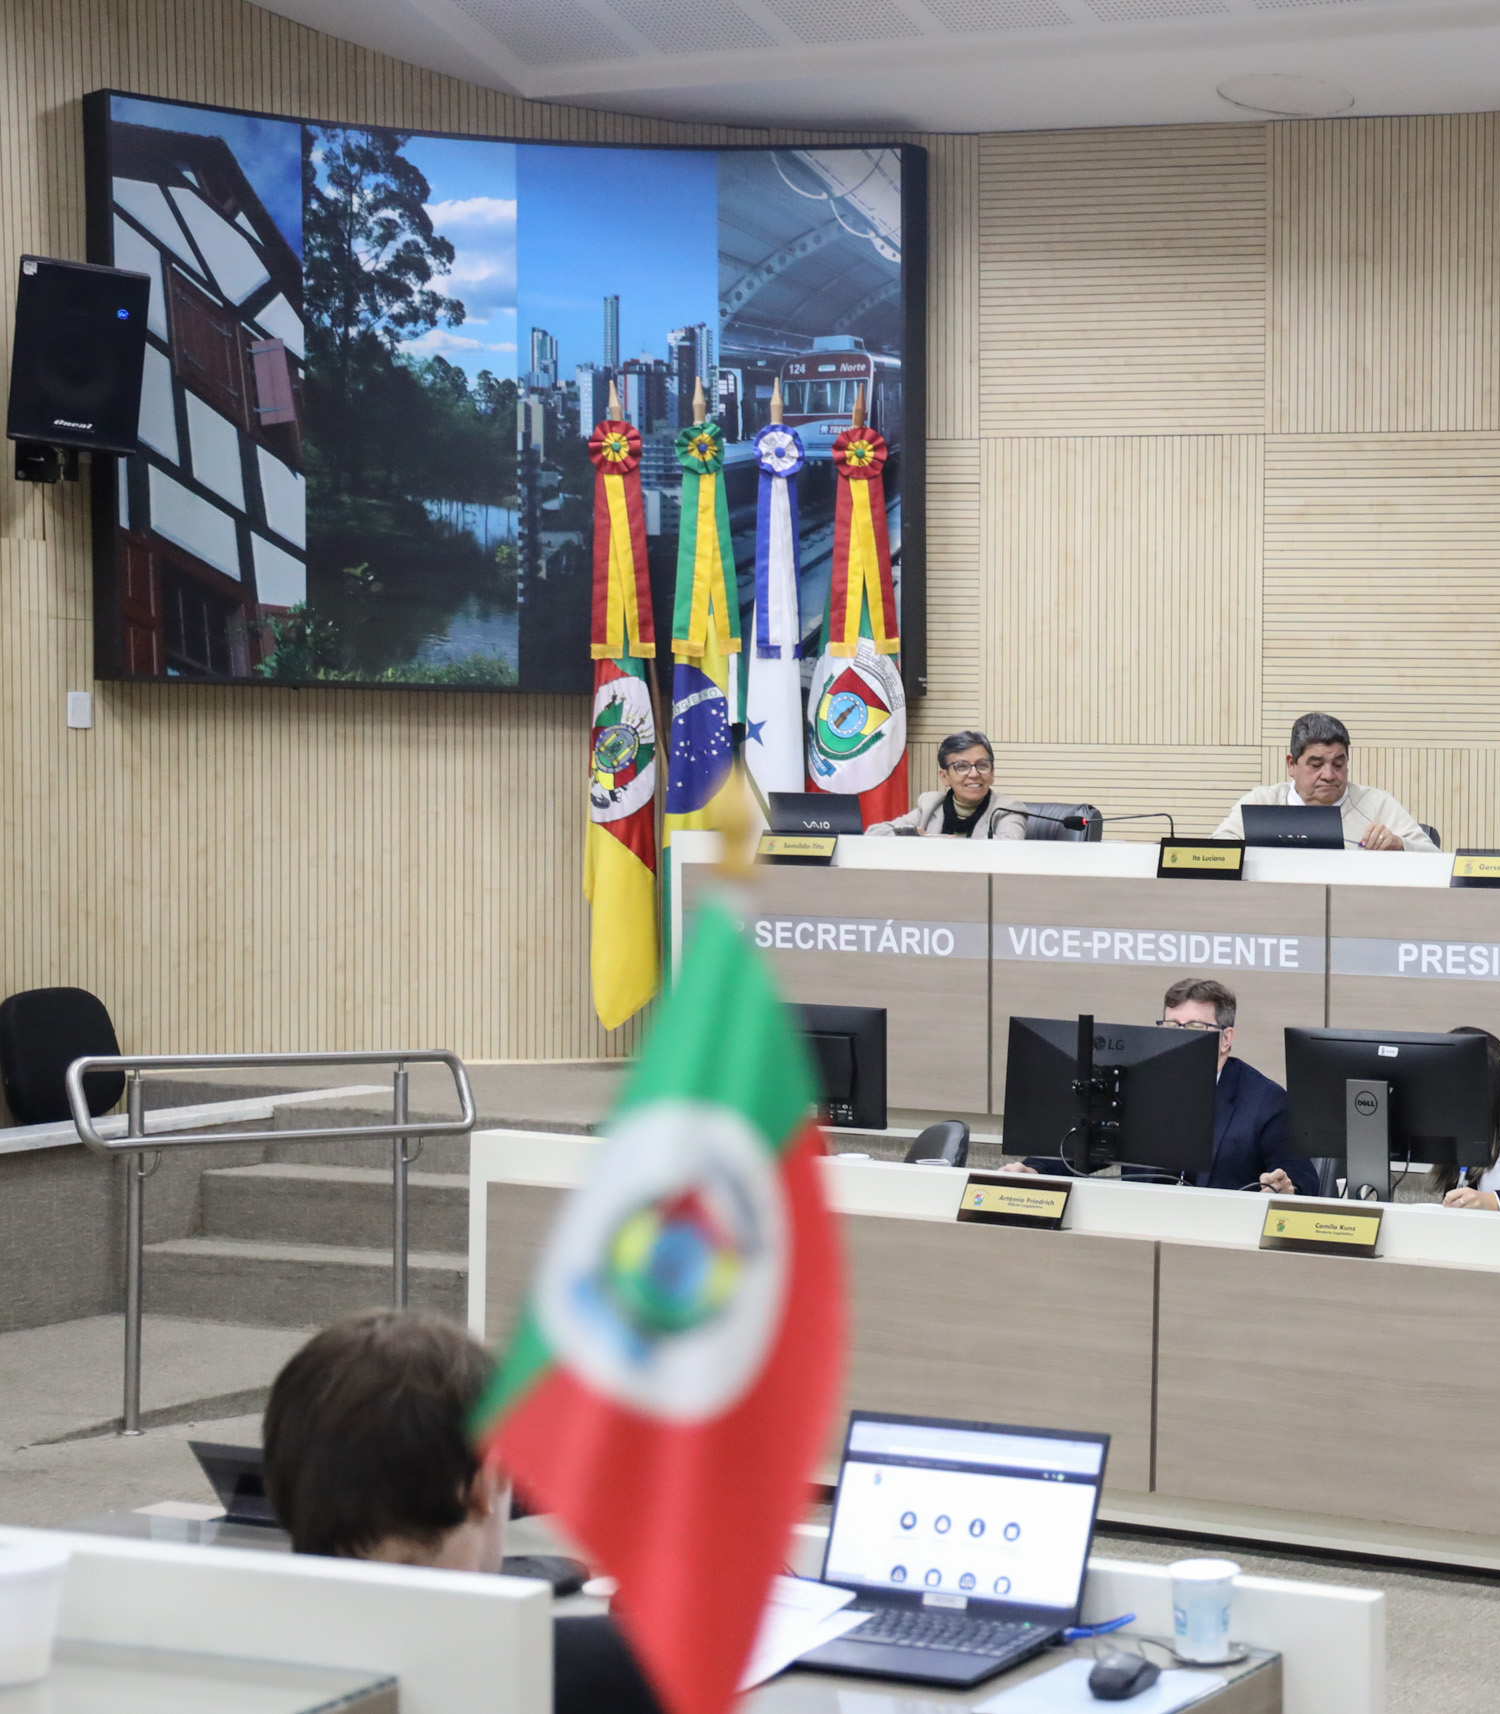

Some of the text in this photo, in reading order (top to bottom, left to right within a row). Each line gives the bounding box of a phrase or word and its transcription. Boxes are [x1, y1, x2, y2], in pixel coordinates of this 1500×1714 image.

[789, 362, 866, 375] 124 Norte
[803, 820, 830, 830] VAIO
[1192, 854, 1226, 862] Ito Luciano
[755, 919, 955, 956] SECRETÁRIO
[1008, 926, 1299, 968] VICE-PRESIDENTE
[1108, 1038, 1124, 1051] LG
[1026, 1197, 1055, 1206] Friedrich
[1315, 1222, 1338, 1230] Camila
